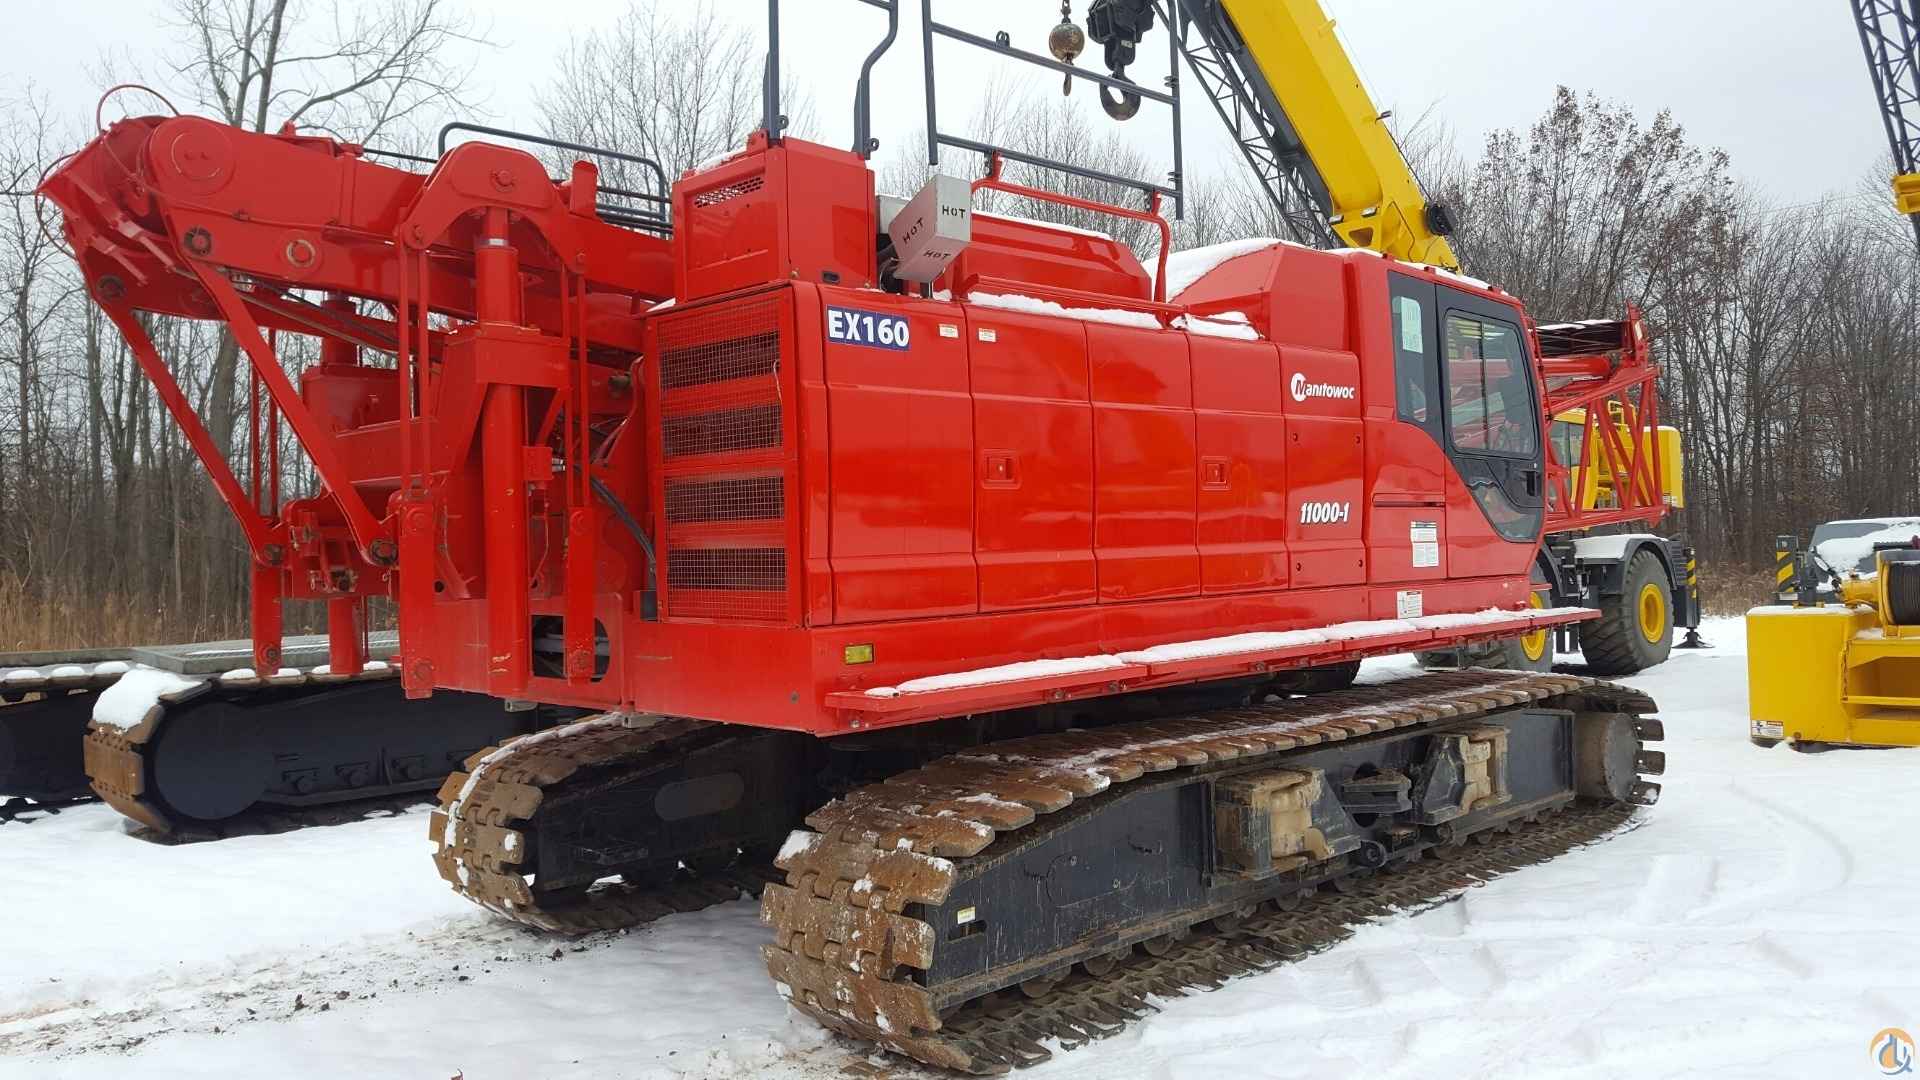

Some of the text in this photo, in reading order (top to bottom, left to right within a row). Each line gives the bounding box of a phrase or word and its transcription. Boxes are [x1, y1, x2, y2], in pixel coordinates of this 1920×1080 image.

[941, 205, 966, 219] HOT
[902, 217, 924, 244] HOT
[923, 250, 951, 260] HOT
[828, 309, 910, 347] EX160
[1291, 373, 1355, 402] Manitowoc
[1300, 502, 1350, 524] 11000-1
